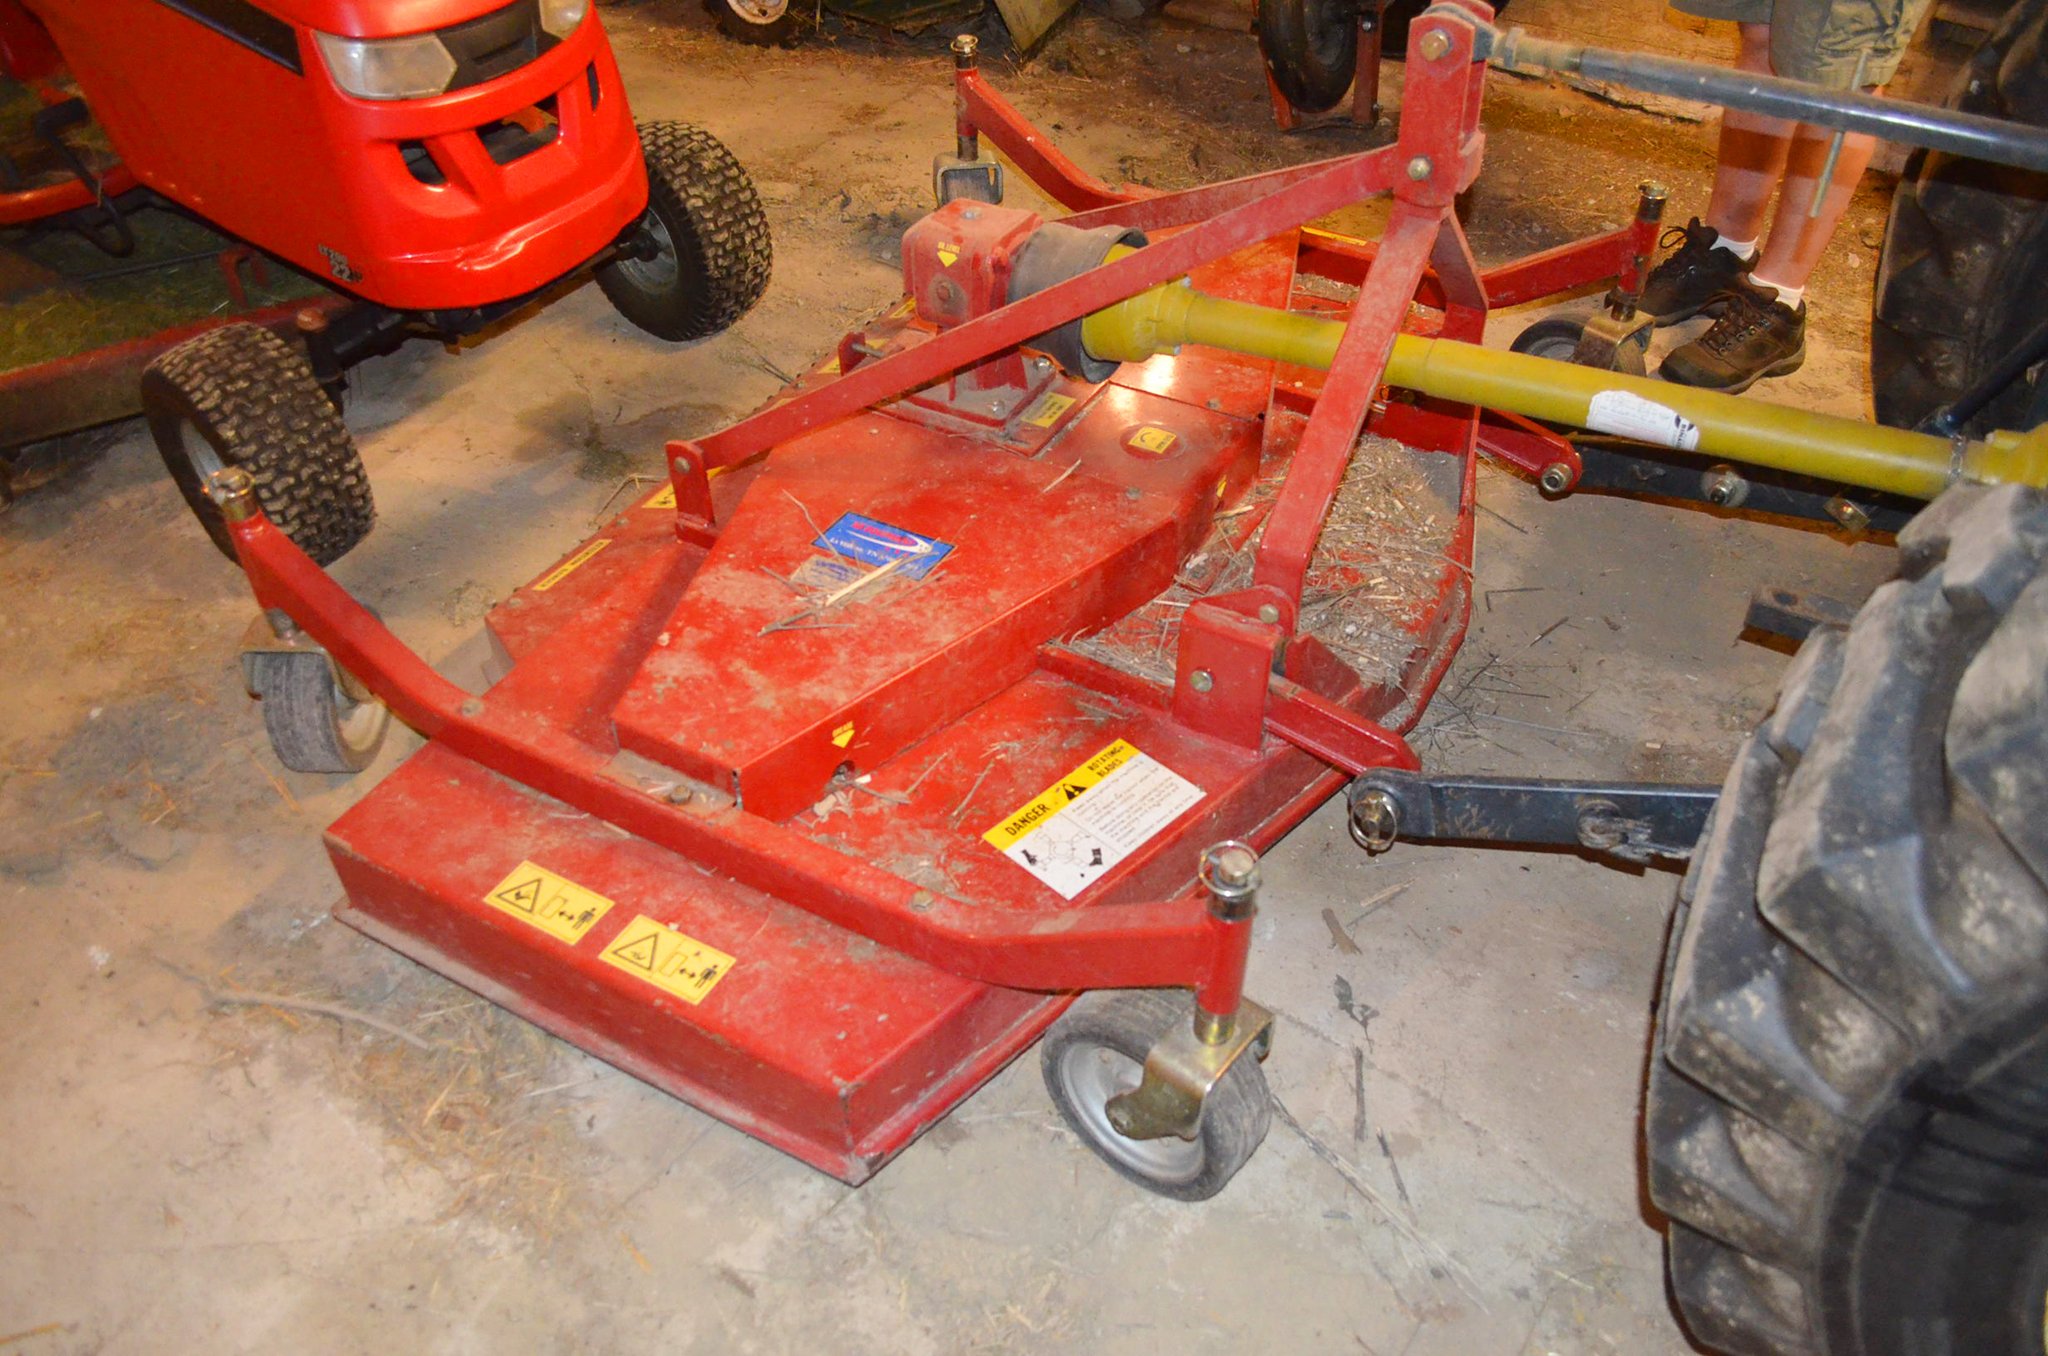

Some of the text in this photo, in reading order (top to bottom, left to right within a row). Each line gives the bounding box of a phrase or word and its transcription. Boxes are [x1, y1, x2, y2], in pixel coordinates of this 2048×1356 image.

[1087, 747, 1121, 771] ROTATING
[1096, 759, 1123, 777] BLADES
[1005, 803, 1051, 836] DANGER
